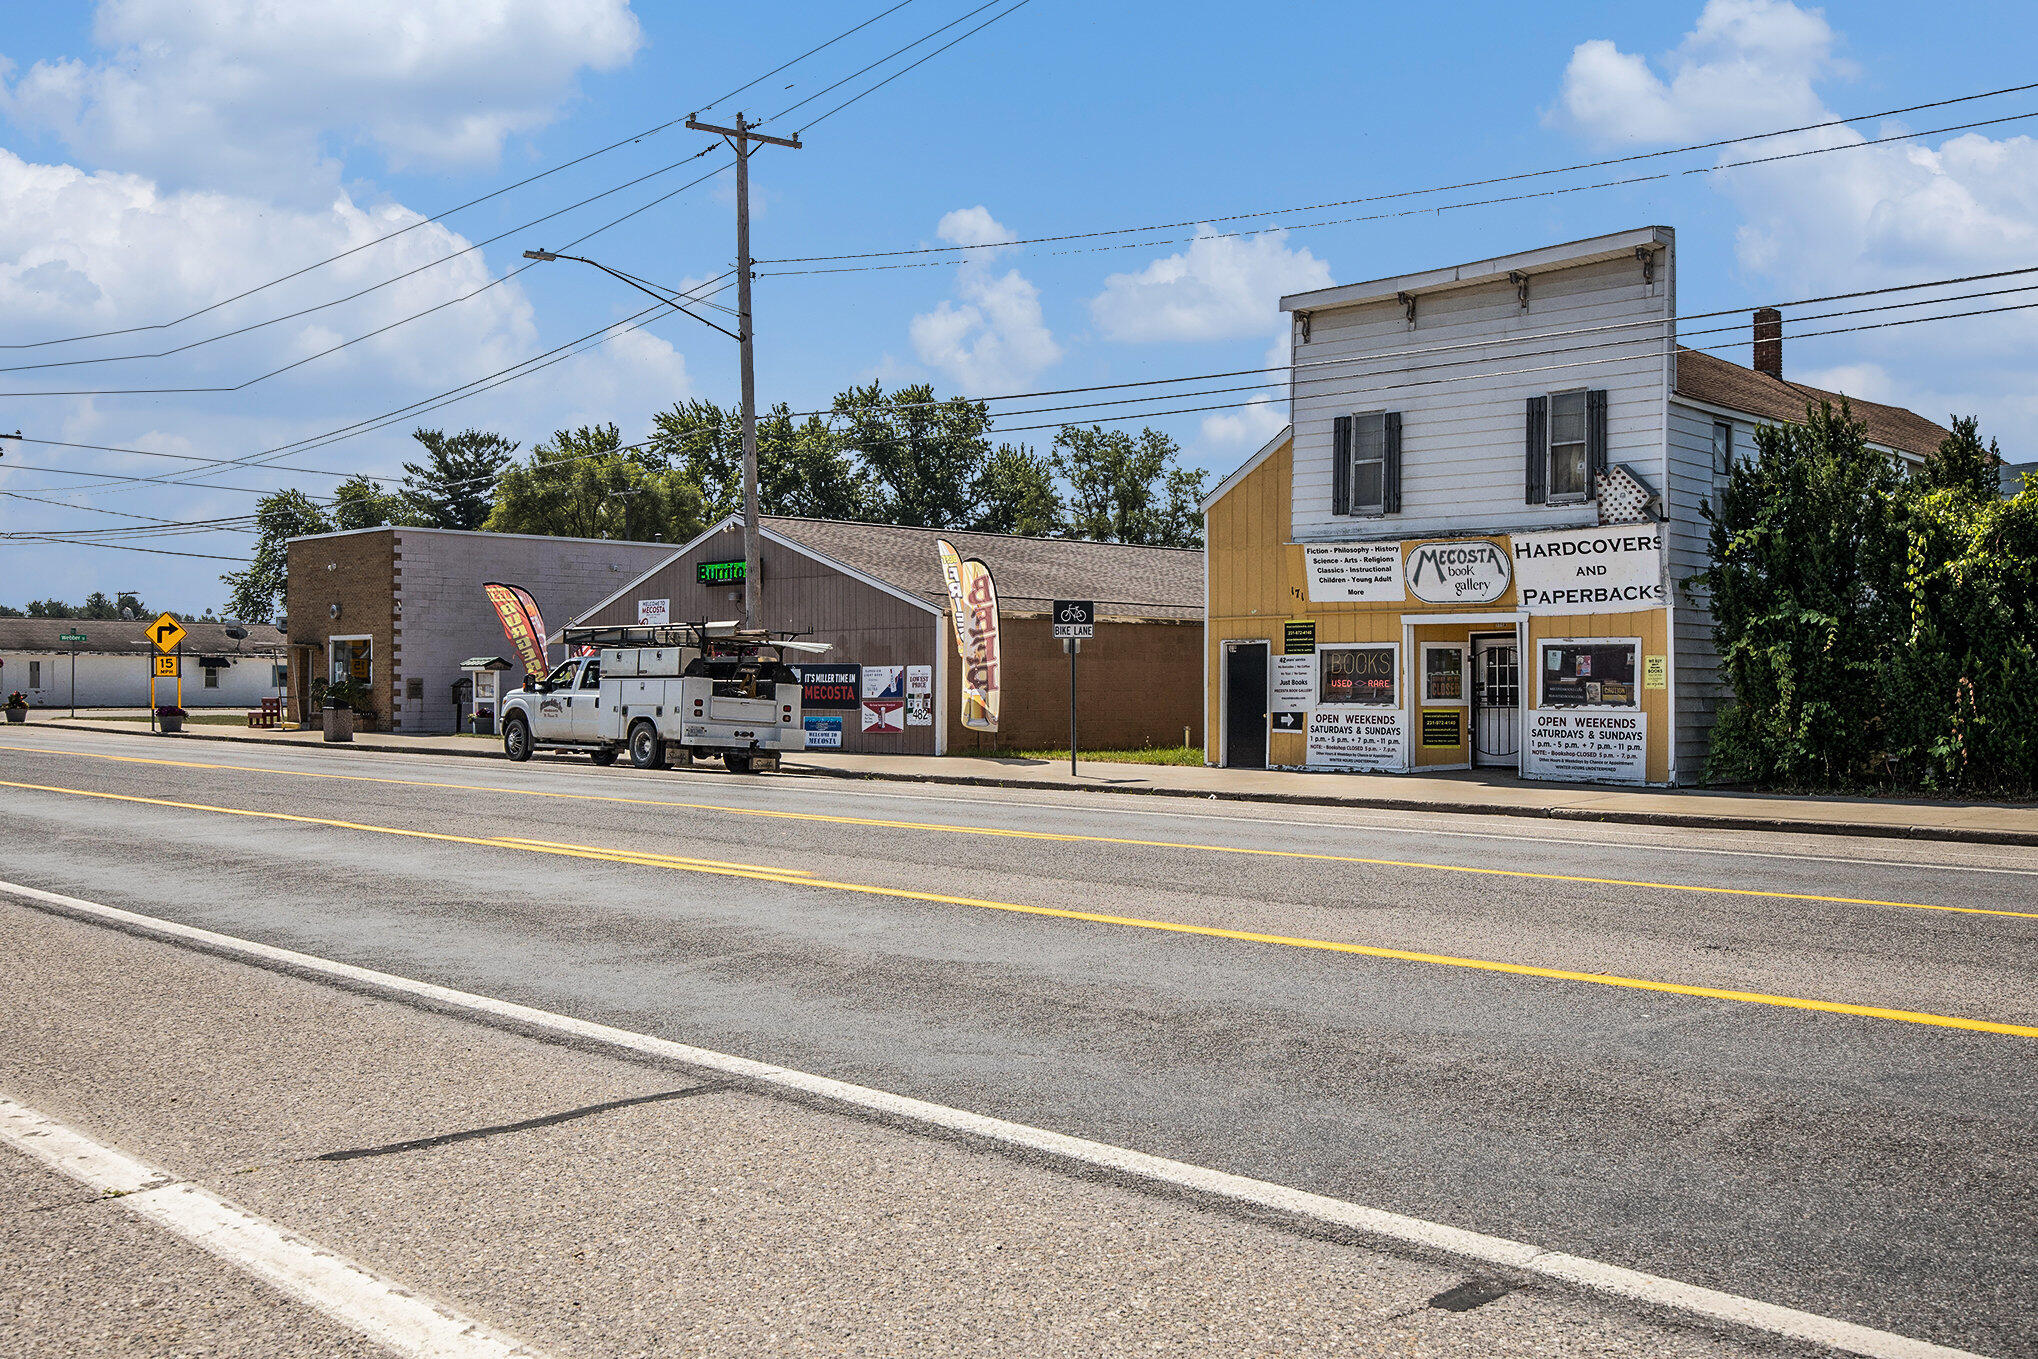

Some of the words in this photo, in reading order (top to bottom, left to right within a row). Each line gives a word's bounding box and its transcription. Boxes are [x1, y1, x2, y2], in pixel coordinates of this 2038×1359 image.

[1515, 536, 1662, 559] HARDCOVERS
[700, 563, 746, 580] Burrito
[1448, 565, 1475, 576] book
[1576, 565, 1607, 576] AND
[1454, 578, 1491, 596] gallery
[1523, 584, 1667, 605] PAPERBACKS
[1055, 625, 1071, 636] BIKE
[1073, 626, 1092, 636] LANE
[160, 659, 173, 668] 15
[1331, 652, 1391, 675] BOOKS
[804, 673, 816, 683] IT'S
[815, 673, 834, 683] MILLER
[834, 673, 849, 683] TIME
[848, 673, 856, 683] IN
[1331, 680, 1353, 688] USED
[1368, 680, 1390, 688] RARE
[804, 685, 855, 700] MECOSTA
[1432, 683, 1460, 696] CLOSED
[912, 709, 928, 720] 482
[1316, 714, 1339, 724] OPEN
[1345, 714, 1395, 725] WEEKENDS
[1538, 716, 1567, 727] OPEN
[1574, 717, 1636, 729] WEEKENDS
[1310, 725, 1352, 734] SATURDAYS
[1365, 727, 1401, 736] SUNDAYS
[1531, 728, 1584, 739] SATURDAYS
[1588, 731, 1595, 739] &
[1599, 731, 1643, 741] SUNDAYS
